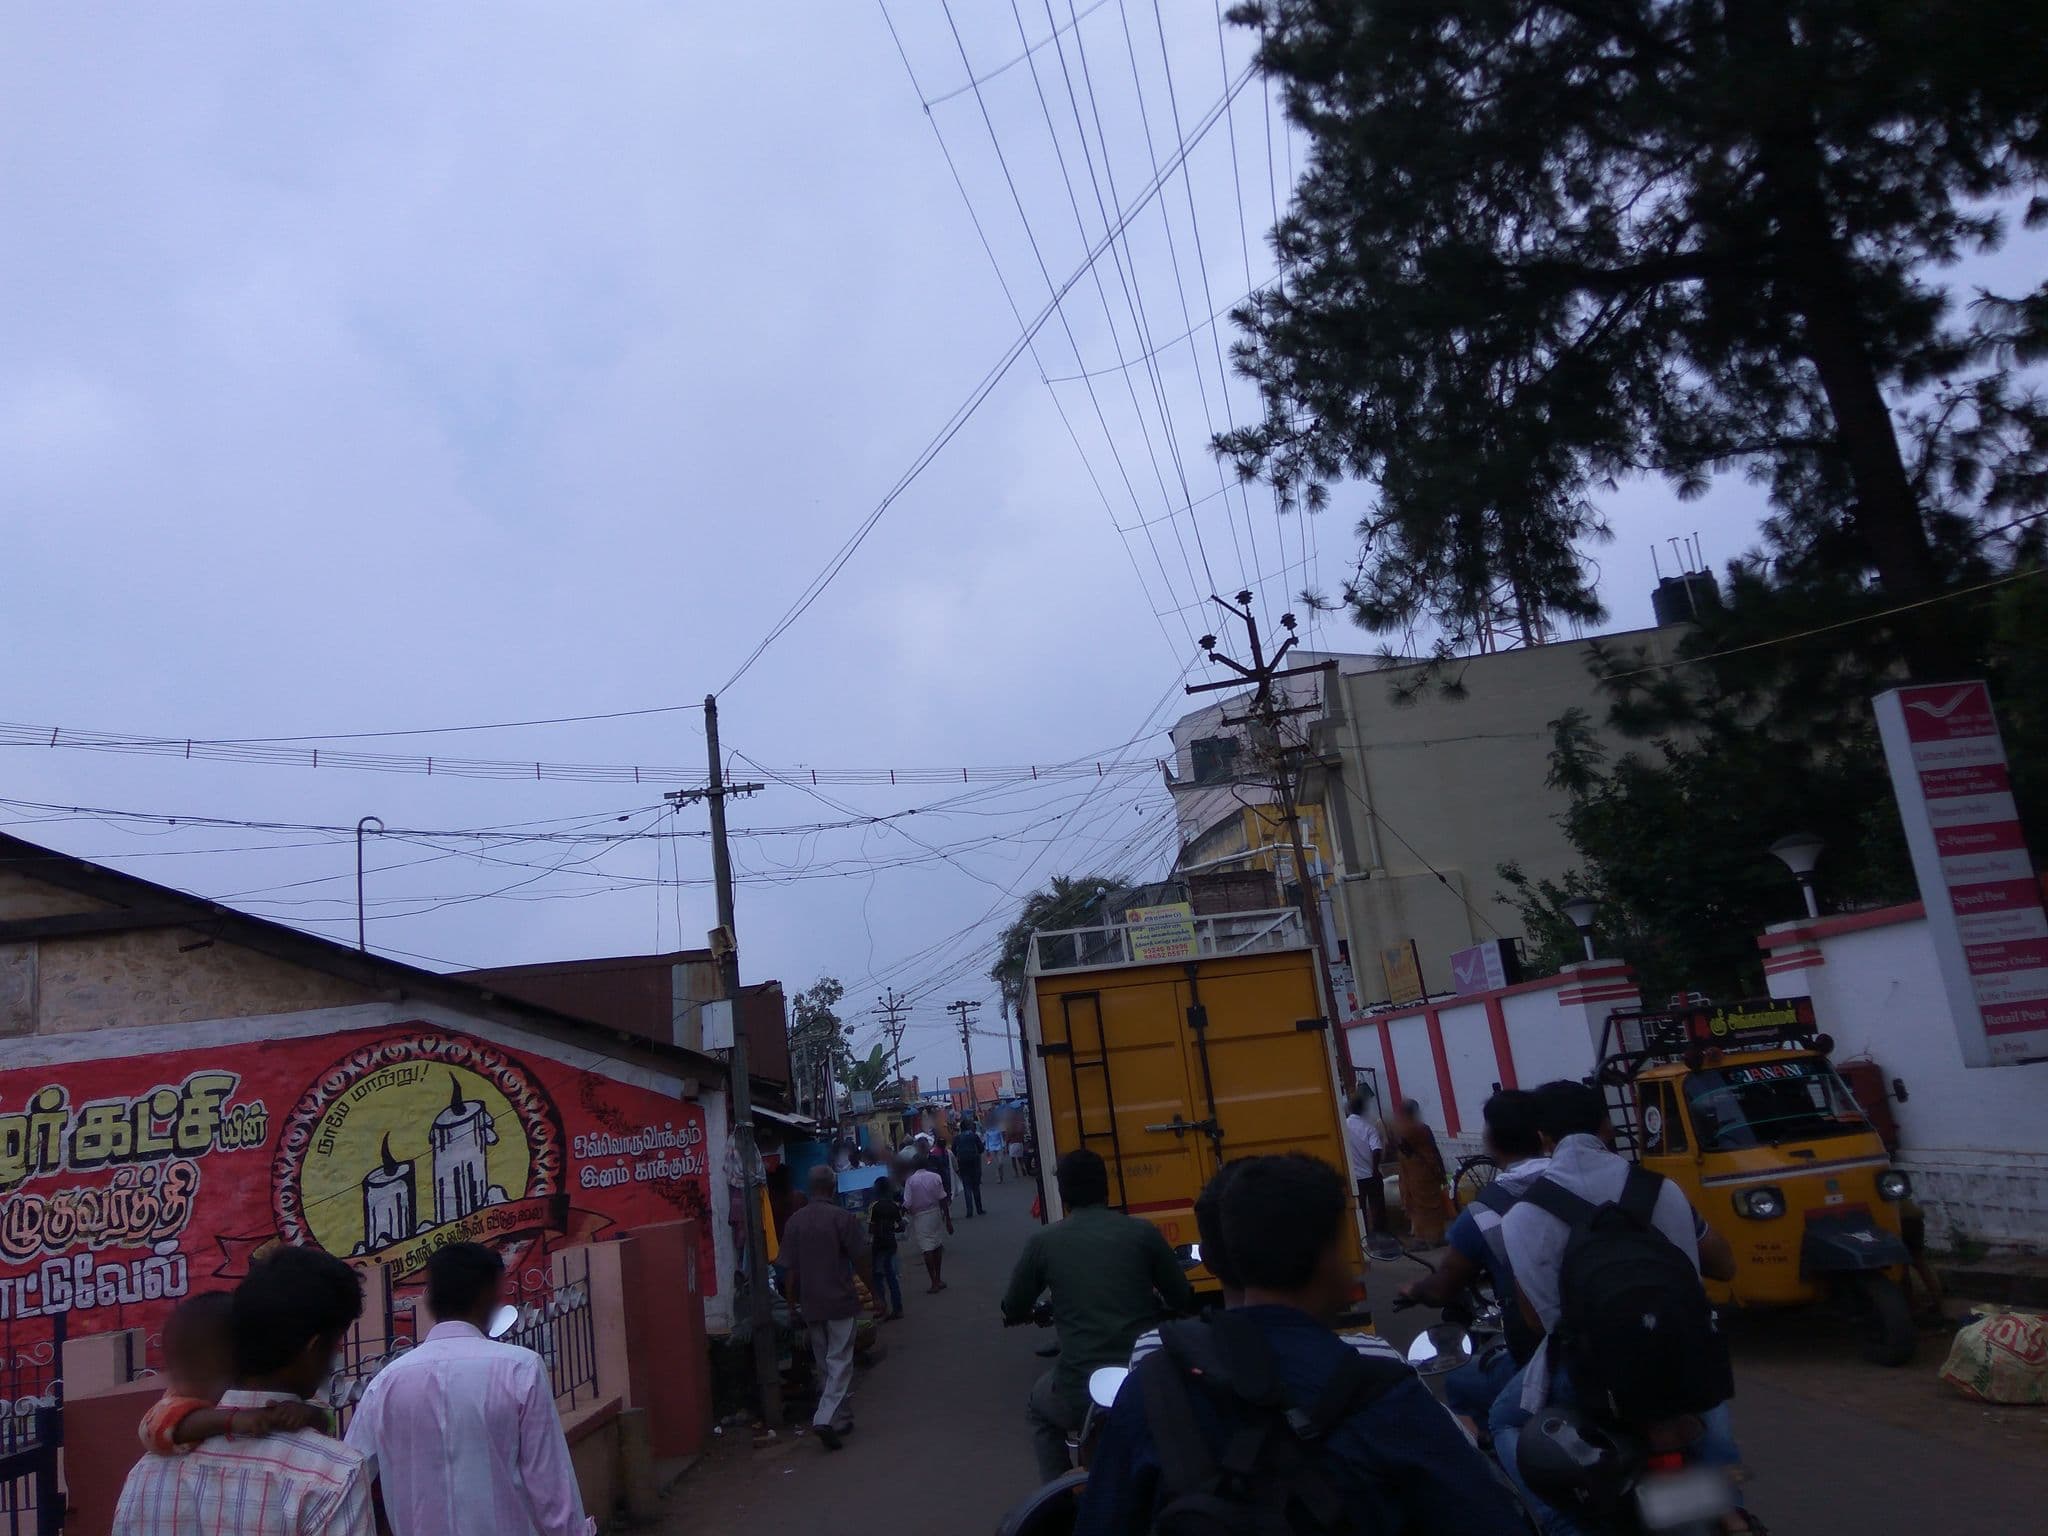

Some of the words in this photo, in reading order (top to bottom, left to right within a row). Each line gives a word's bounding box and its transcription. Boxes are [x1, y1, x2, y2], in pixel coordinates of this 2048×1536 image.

[1953, 892, 1983, 908] Speed
[1985, 889, 2007, 902] Post
[1968, 944, 2005, 957] Instant
[1971, 958, 2008, 971] Money
[2010, 954, 2041, 966] Order
[1980, 991, 2001, 1002] Life
[1984, 1010, 2018, 1027] Retail
[2020, 1007, 2047, 1023] Post
[1743, 1063, 1803, 1083] JANANI
[317, 1101, 351, 1157] நாமே
[351, 1063, 430, 1102] மாற்று!
[580, 1158, 630, 1188] இனம்
